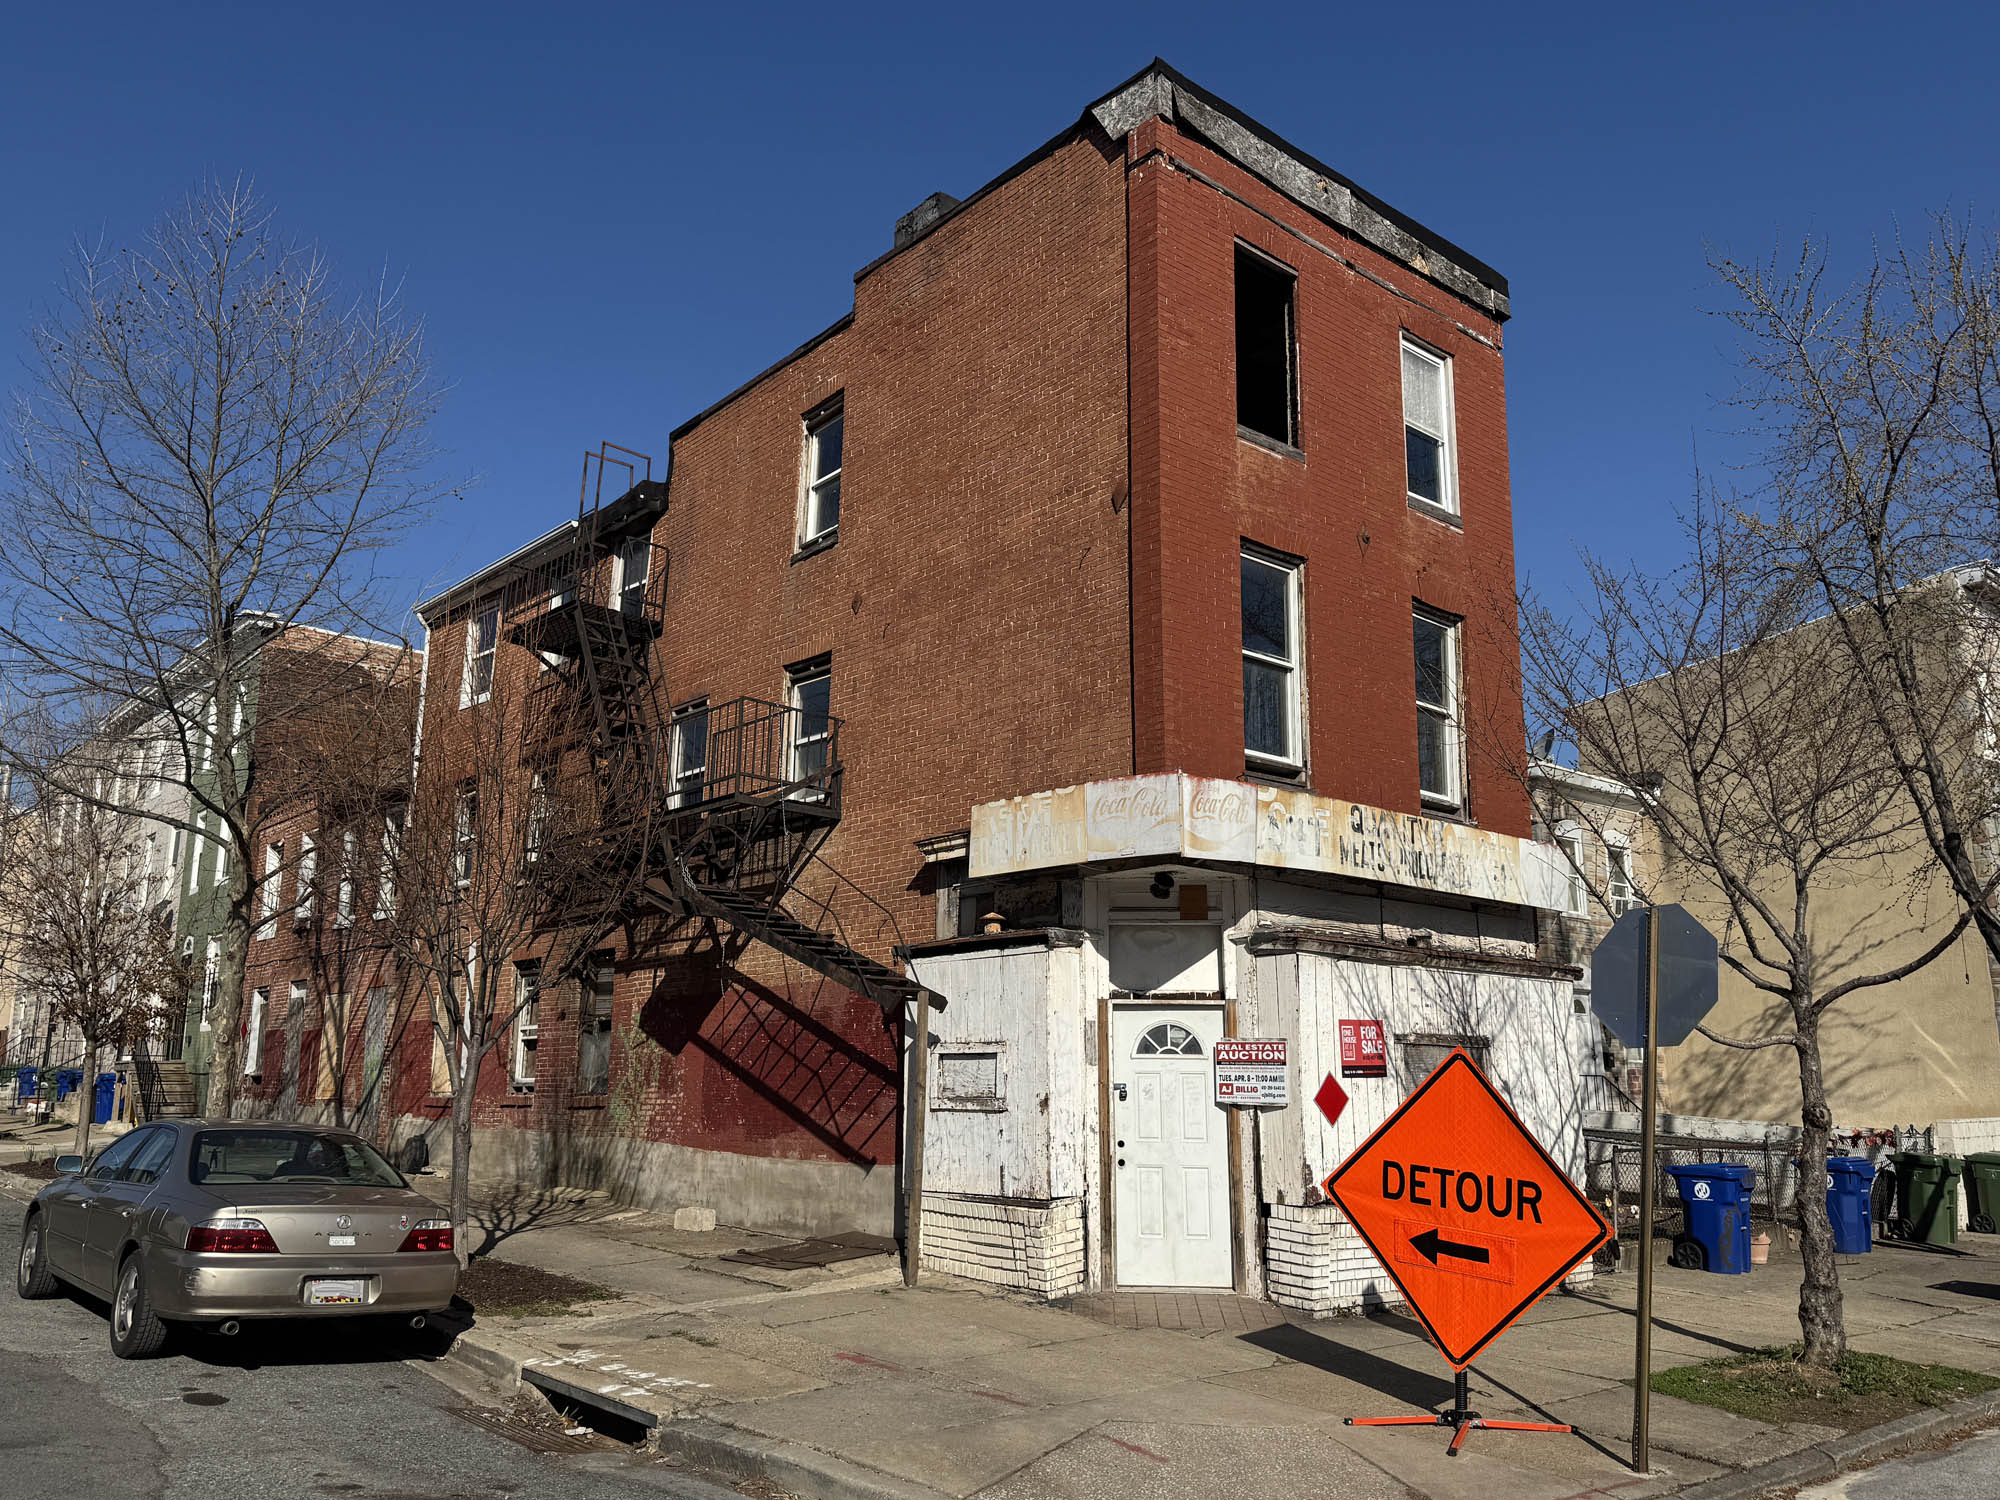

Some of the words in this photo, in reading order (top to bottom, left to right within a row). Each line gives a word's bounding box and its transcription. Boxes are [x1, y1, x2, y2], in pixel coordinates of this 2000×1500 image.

[1360, 1025, 1377, 1040] FOR
[1217, 1043, 1244, 1051] REAL
[1245, 1043, 1285, 1051] ESTATE
[1361, 1040, 1383, 1054] SALE
[1218, 1050, 1285, 1060] AUCTION
[1219, 1074, 1233, 1082] TUES.
[1234, 1074, 1246, 1082] APR.
[1255, 1074, 1268, 1082] 11:00
[1221, 1085, 1233, 1093] AJ
[1235, 1085, 1259, 1093] BILLIG
[1382, 1159, 1543, 1225] DETOUR
